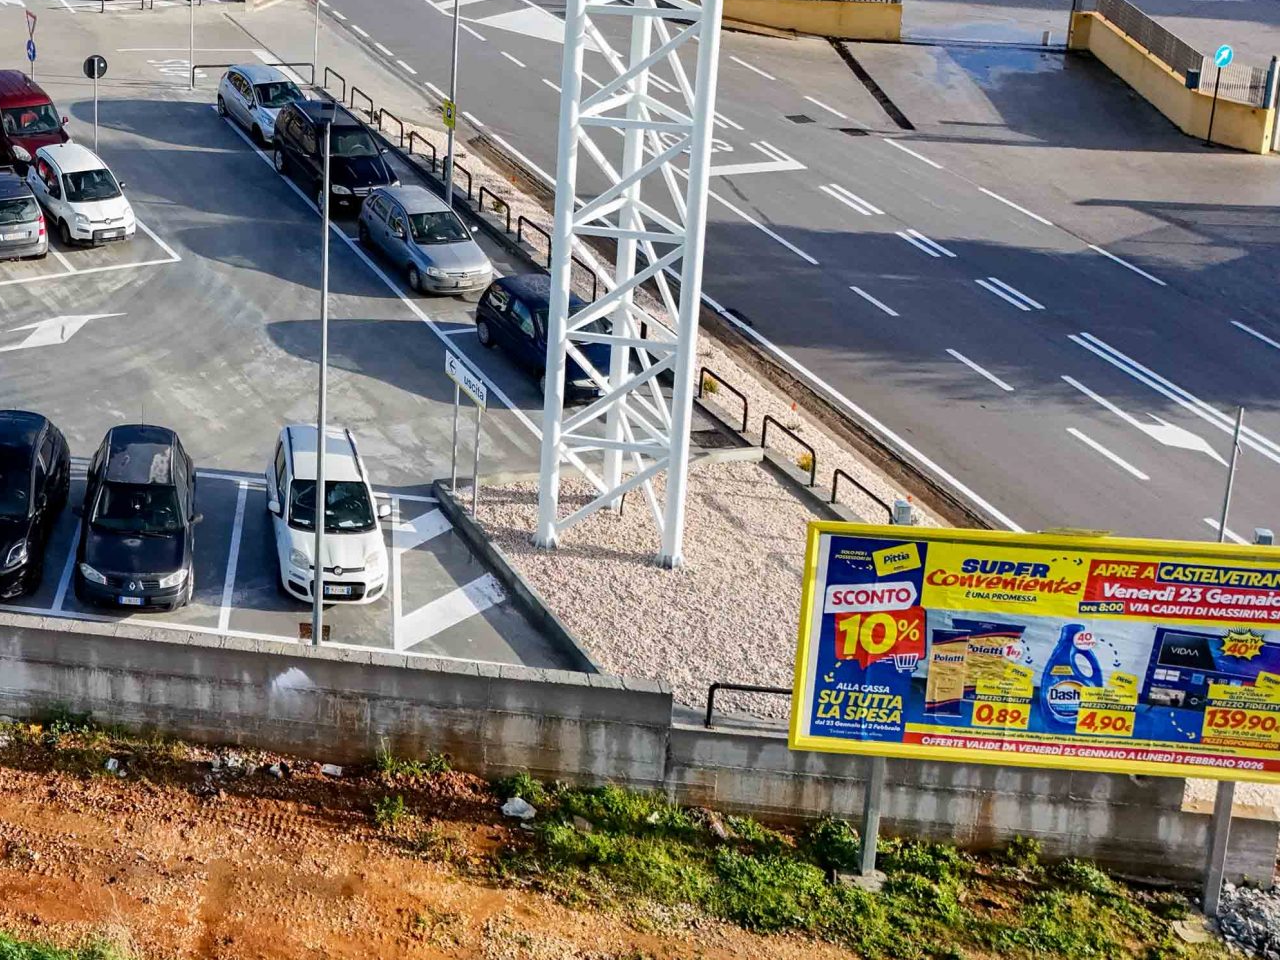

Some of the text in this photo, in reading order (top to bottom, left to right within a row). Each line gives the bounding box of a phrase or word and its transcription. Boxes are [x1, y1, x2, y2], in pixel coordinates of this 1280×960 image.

[463, 375, 484, 401] uscita
[962, 559, 1051, 578] SUPER
[1093, 563, 1139, 578] APRE
[1141, 567, 1155, 580] A
[926, 569, 1082, 595] Conveniente
[832, 587, 911, 606] SCONTO
[971, 592, 990, 600] UNA
[991, 593, 1037, 602] PROMESSA
[1103, 582, 1176, 602] Venerdì
[1178, 588, 1202, 603] 23
[1098, 603, 1124, 612] 8:00
[1129, 603, 1149, 613] VIA
[1151, 604, 1193, 615] CADUTI
[1195, 606, 1207, 616] DI
[1208, 607, 1268, 619] NASSIRIYA
[839, 612, 920, 656] 10%
[1077, 632, 1093, 642] 40
[1229, 635, 1247, 643] Smart
[934, 653, 964, 663] Poiatti
[836, 682, 890, 693] ALLA CASSA
[1050, 688, 1080, 701] Dash
[818, 690, 903, 709] SU TUTTA
[1001, 696, 1030, 704] FIDELITY
[1107, 703, 1136, 711] FIDELITY
[1212, 700, 1280, 711] PREZZO FIDELITY
[816, 704, 840, 718] LA
[975, 703, 1028, 725] 0,89€
[835, 721, 861, 729] Gennaio
[873, 723, 901, 732] Febbraio
[1078, 711, 1132, 732] 4,90€
[921, 736, 964, 748] OFFERTE
[965, 739, 1001, 751] VALIDE
[1002, 742, 1017, 752] DA
[1019, 743, 1064, 755] VENERDÌ
[1064, 747, 1076, 756] 23
[1077, 747, 1126, 759] GENNAIO
[1128, 752, 1136, 760] A
[1137, 752, 1175, 763] LUNEDÌ
[1176, 756, 1183, 764] 2
[1184, 756, 1236, 768] FEBBRAIO
[1237, 760, 1264, 770] 2026
